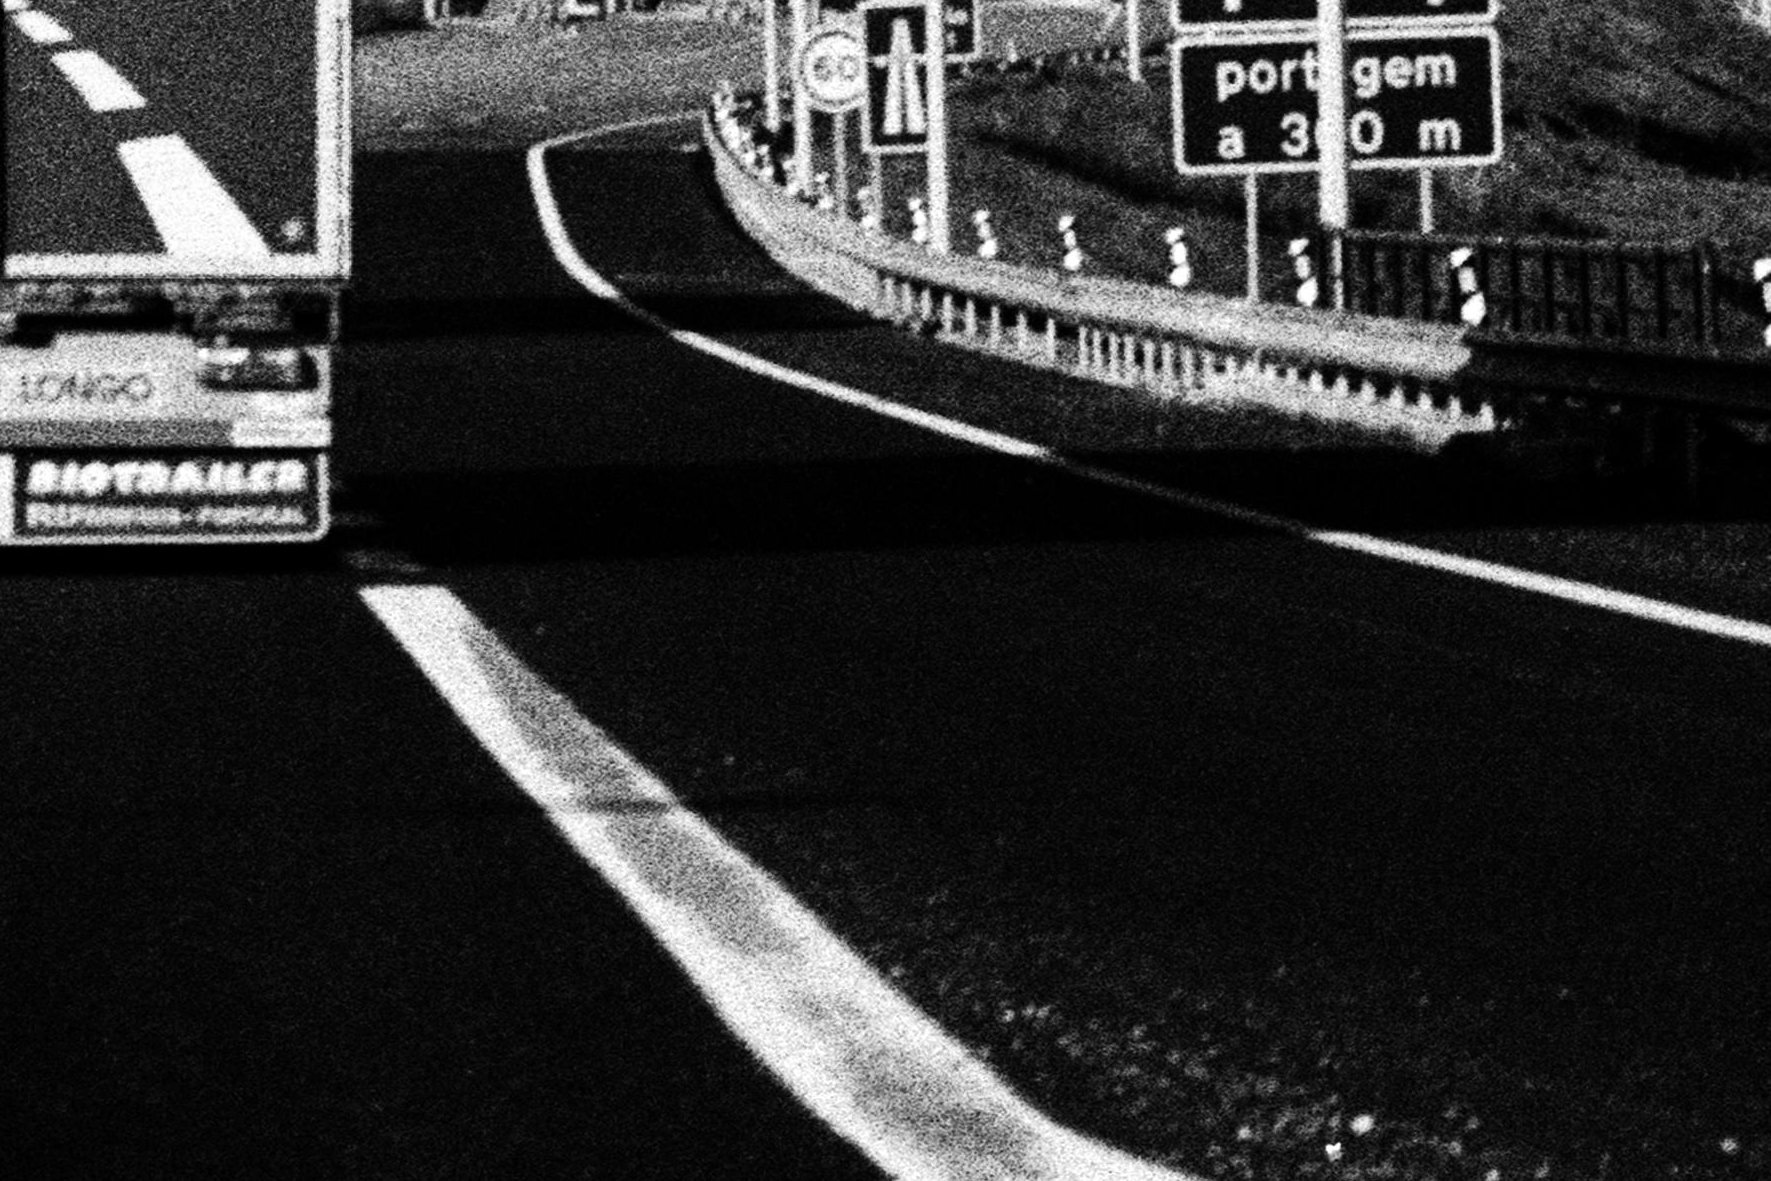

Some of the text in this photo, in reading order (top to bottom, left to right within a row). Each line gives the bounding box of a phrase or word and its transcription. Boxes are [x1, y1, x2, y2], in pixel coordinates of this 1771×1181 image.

[1216, 48, 1458, 103] portgem
[1217, 111, 1462, 160] a 30 m
